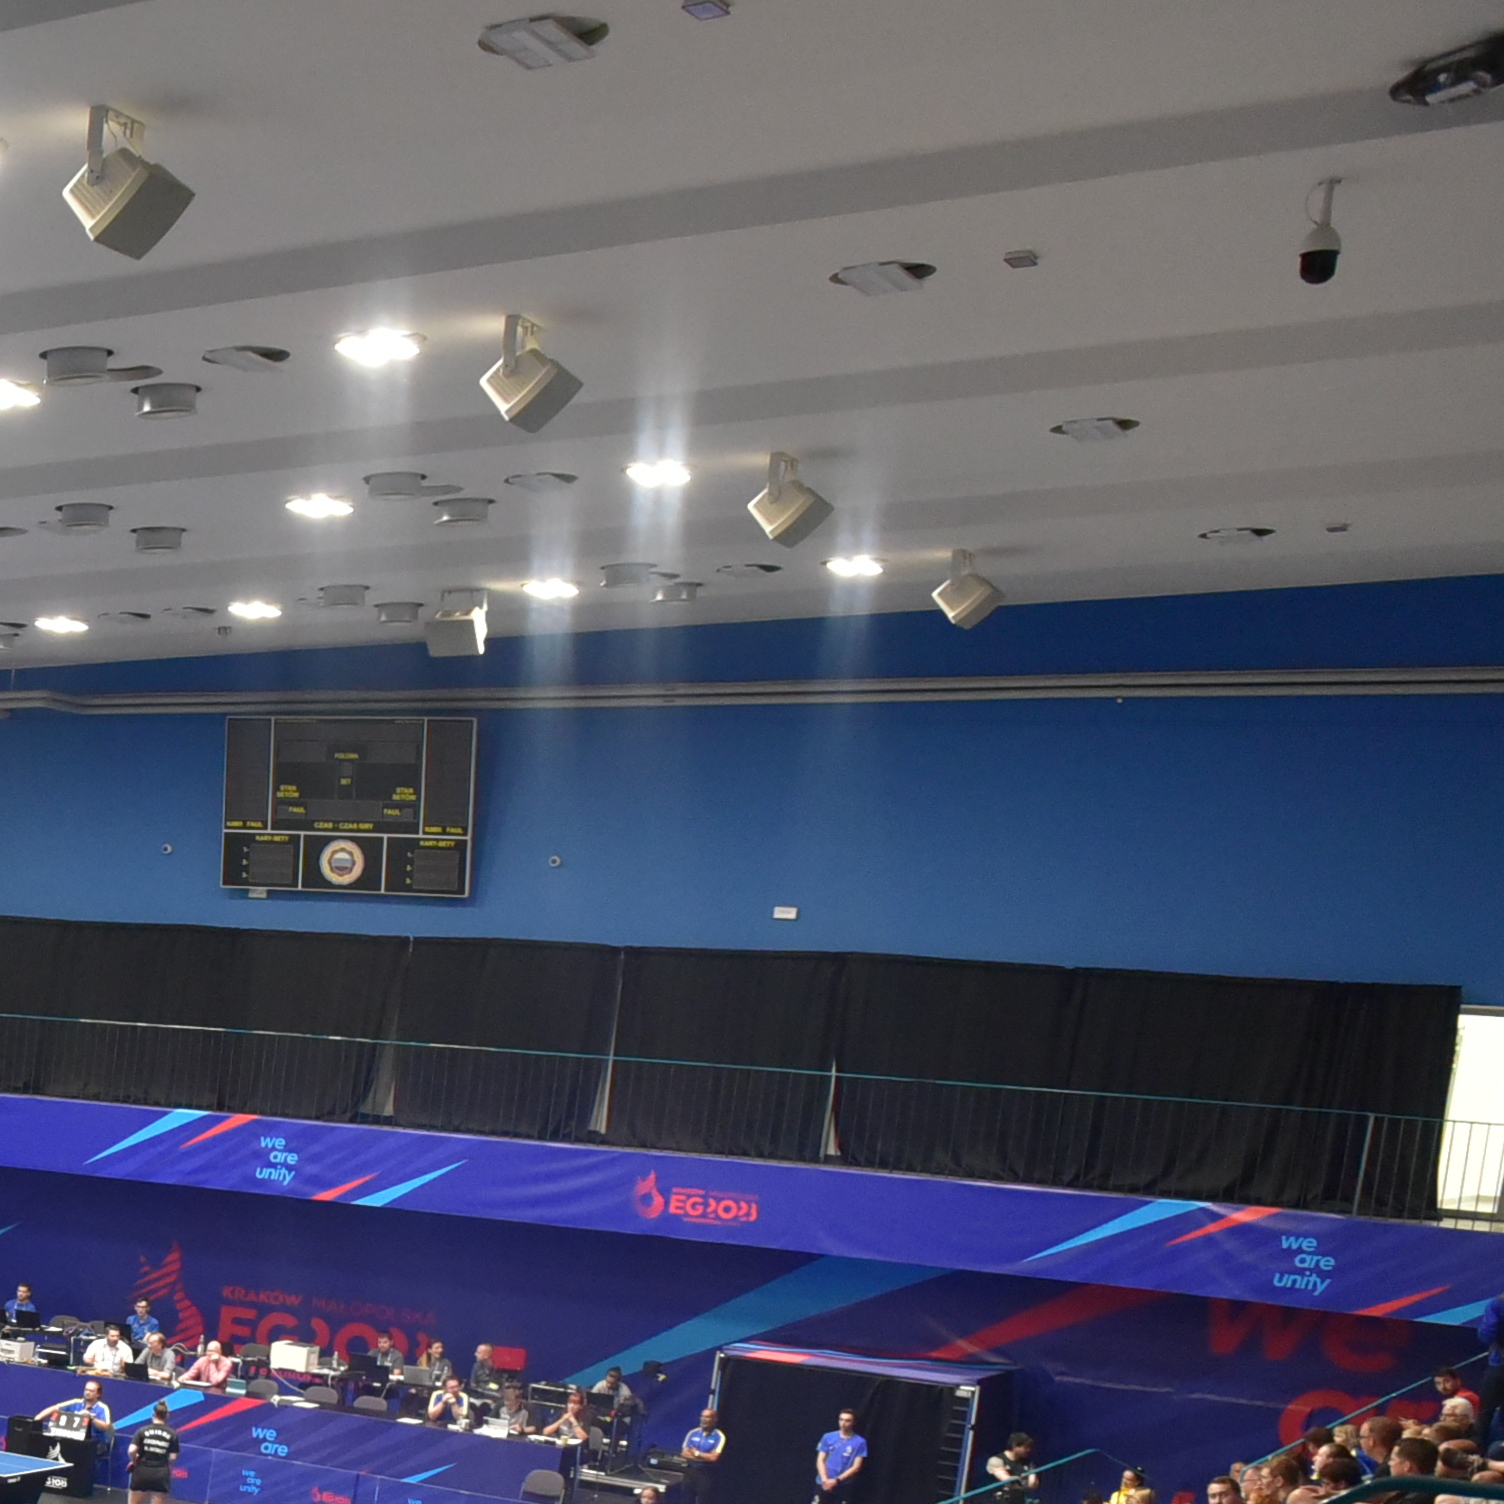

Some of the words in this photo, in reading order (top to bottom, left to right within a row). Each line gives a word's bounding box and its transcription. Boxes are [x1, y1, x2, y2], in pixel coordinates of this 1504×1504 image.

[260, 1135, 285, 1150] we
[270, 1149, 298, 1164] are
[255, 1165, 296, 1184] unity
[669, 1194, 759, 1222] EG2023
[1281, 1235, 1317, 1251] we
[1294, 1253, 1335, 1270] are
[1273, 1271, 1331, 1295] unity
[222, 1285, 303, 1306] KRAKÓW
[252, 1427, 276, 1440] we
[261, 1440, 288, 1457] are
[242, 1470, 256, 1478] we
[247, 1477, 261, 1485] are
[240, 1484, 260, 1496] unity
